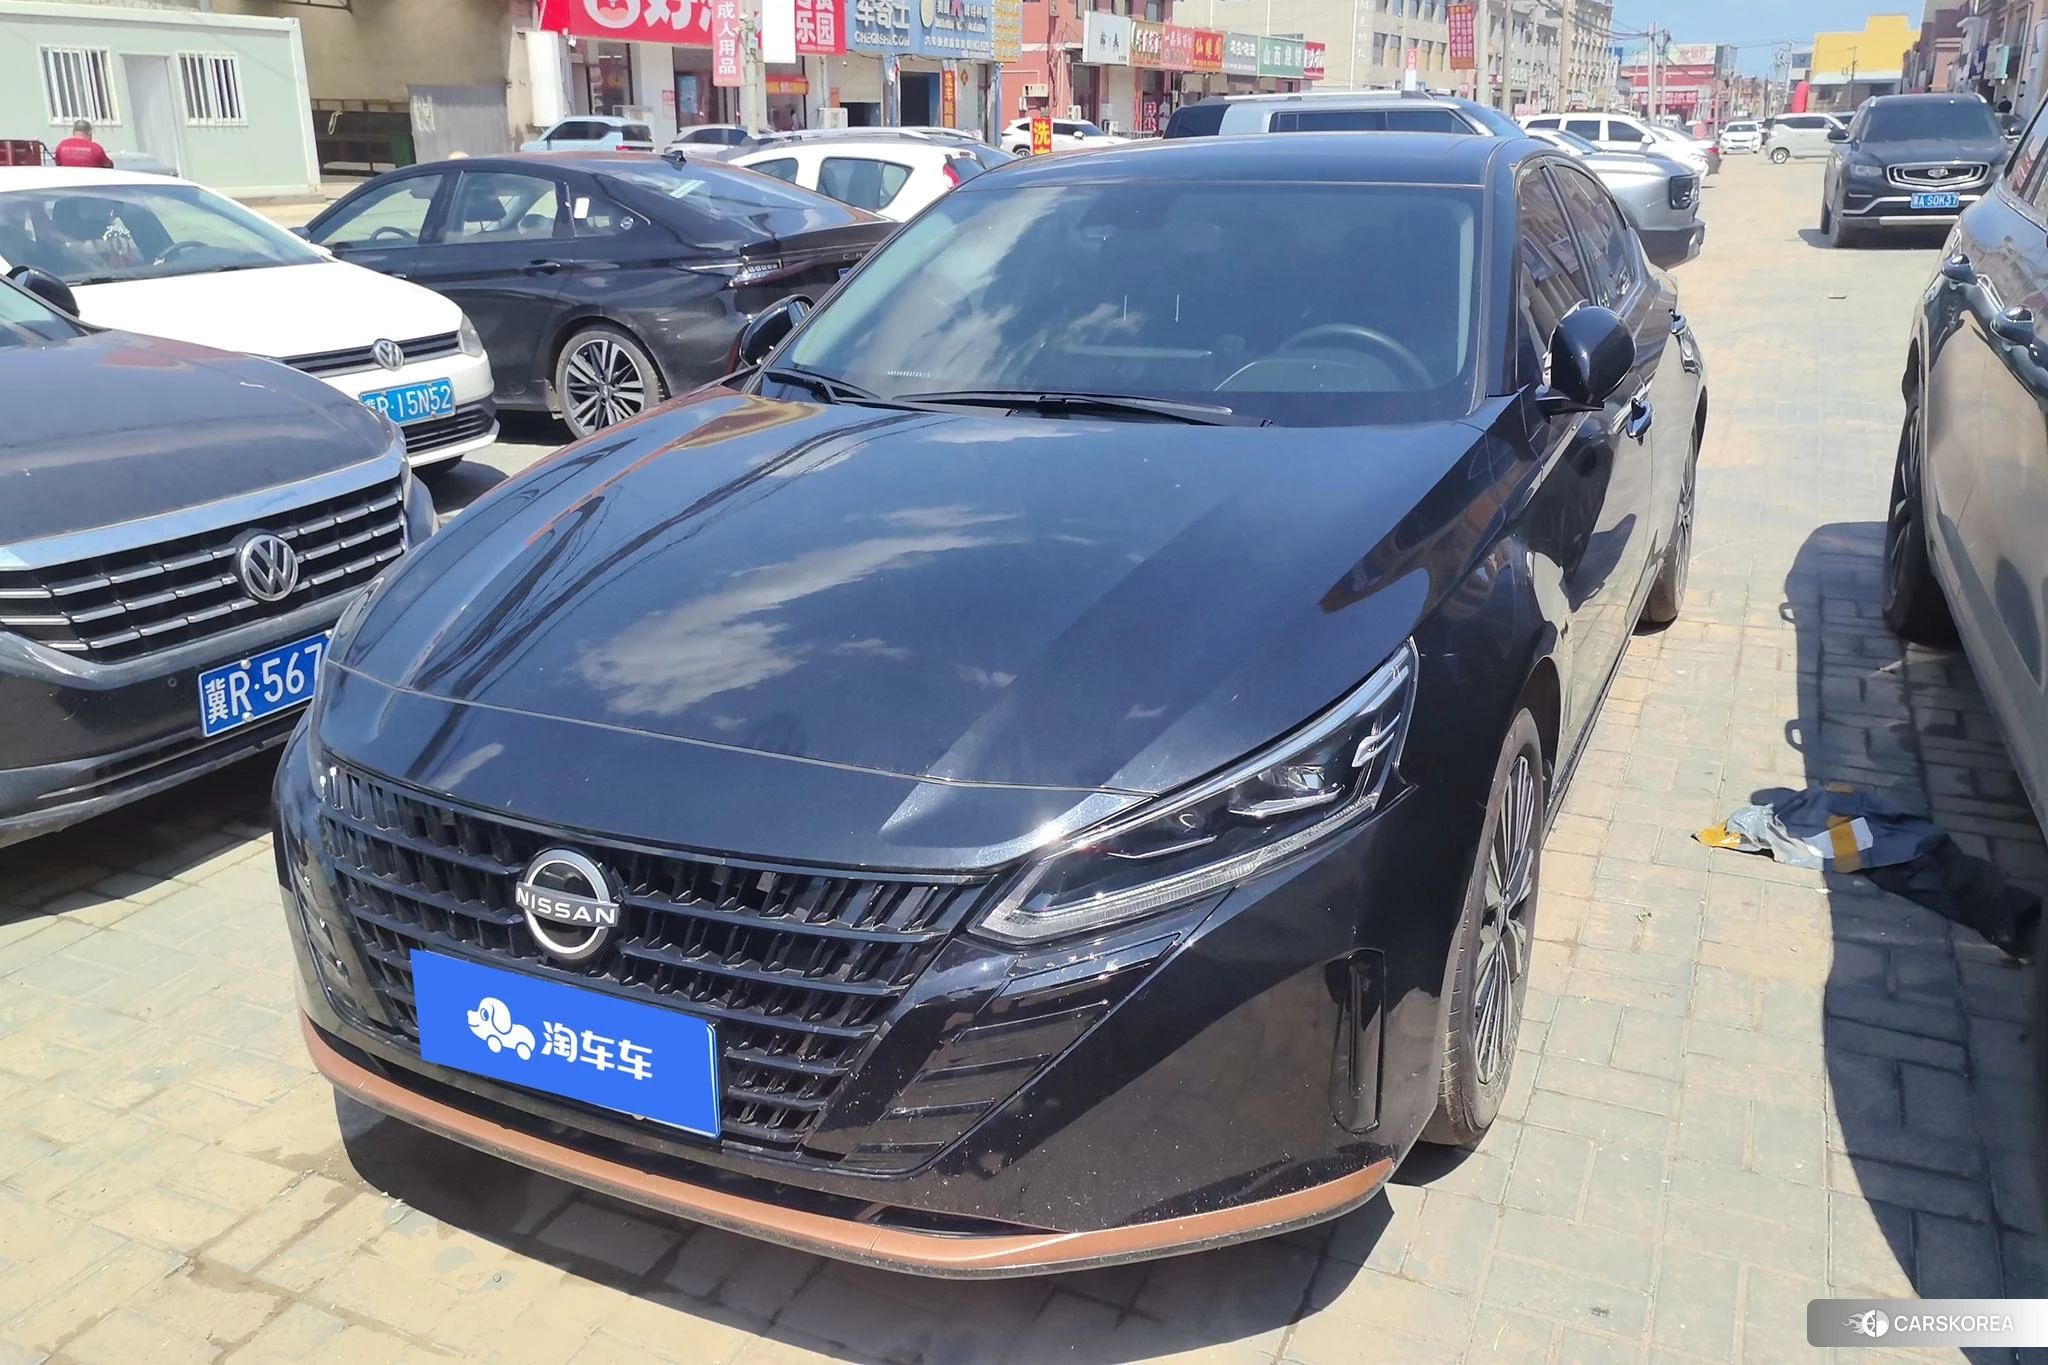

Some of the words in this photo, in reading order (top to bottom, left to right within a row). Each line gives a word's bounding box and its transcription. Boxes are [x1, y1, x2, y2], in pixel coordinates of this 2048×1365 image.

[716, 1, 737, 75] 成人用品
[516, 886, 616, 925] NISSAN
